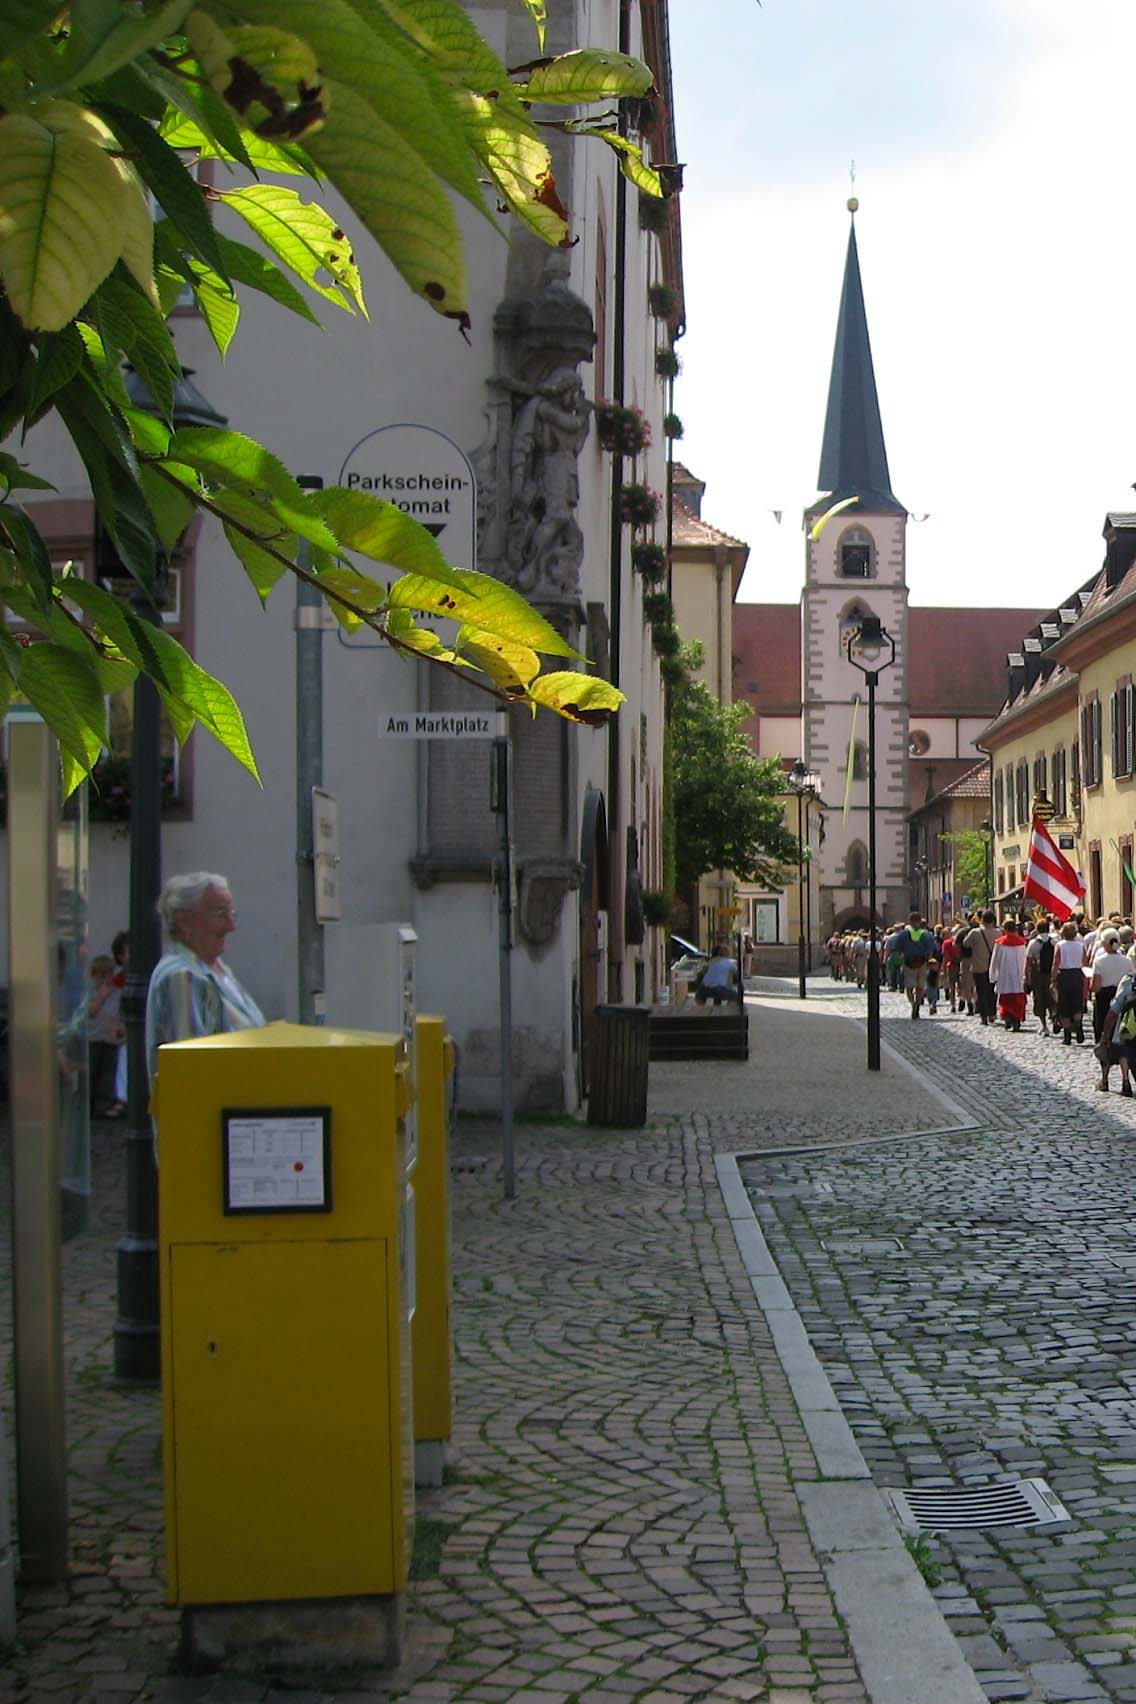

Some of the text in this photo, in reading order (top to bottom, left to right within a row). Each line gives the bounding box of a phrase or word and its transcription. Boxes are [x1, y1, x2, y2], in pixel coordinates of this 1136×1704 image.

[347, 473, 469, 490] Parkschein-
[391, 498, 451, 514] omat
[386, 716, 489, 736] Am Marktplatz
